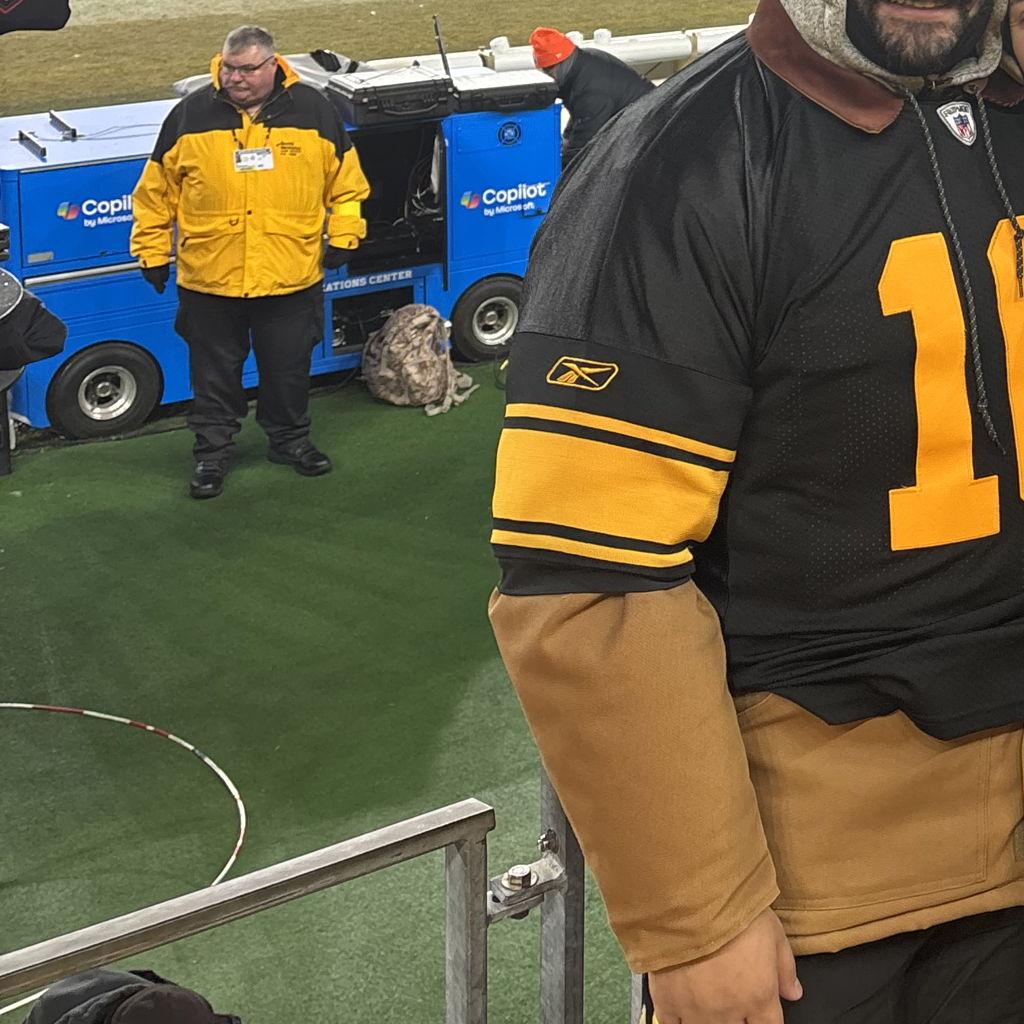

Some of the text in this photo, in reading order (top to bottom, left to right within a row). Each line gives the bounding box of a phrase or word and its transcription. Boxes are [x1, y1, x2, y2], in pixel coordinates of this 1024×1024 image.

[482, 181, 548, 205] Copilot
[81, 194, 132, 216] Copil
[484, 202, 535, 217] by Microsoft
[83, 214, 133, 228] by Microso
[368, 270, 413, 285] CENTER
